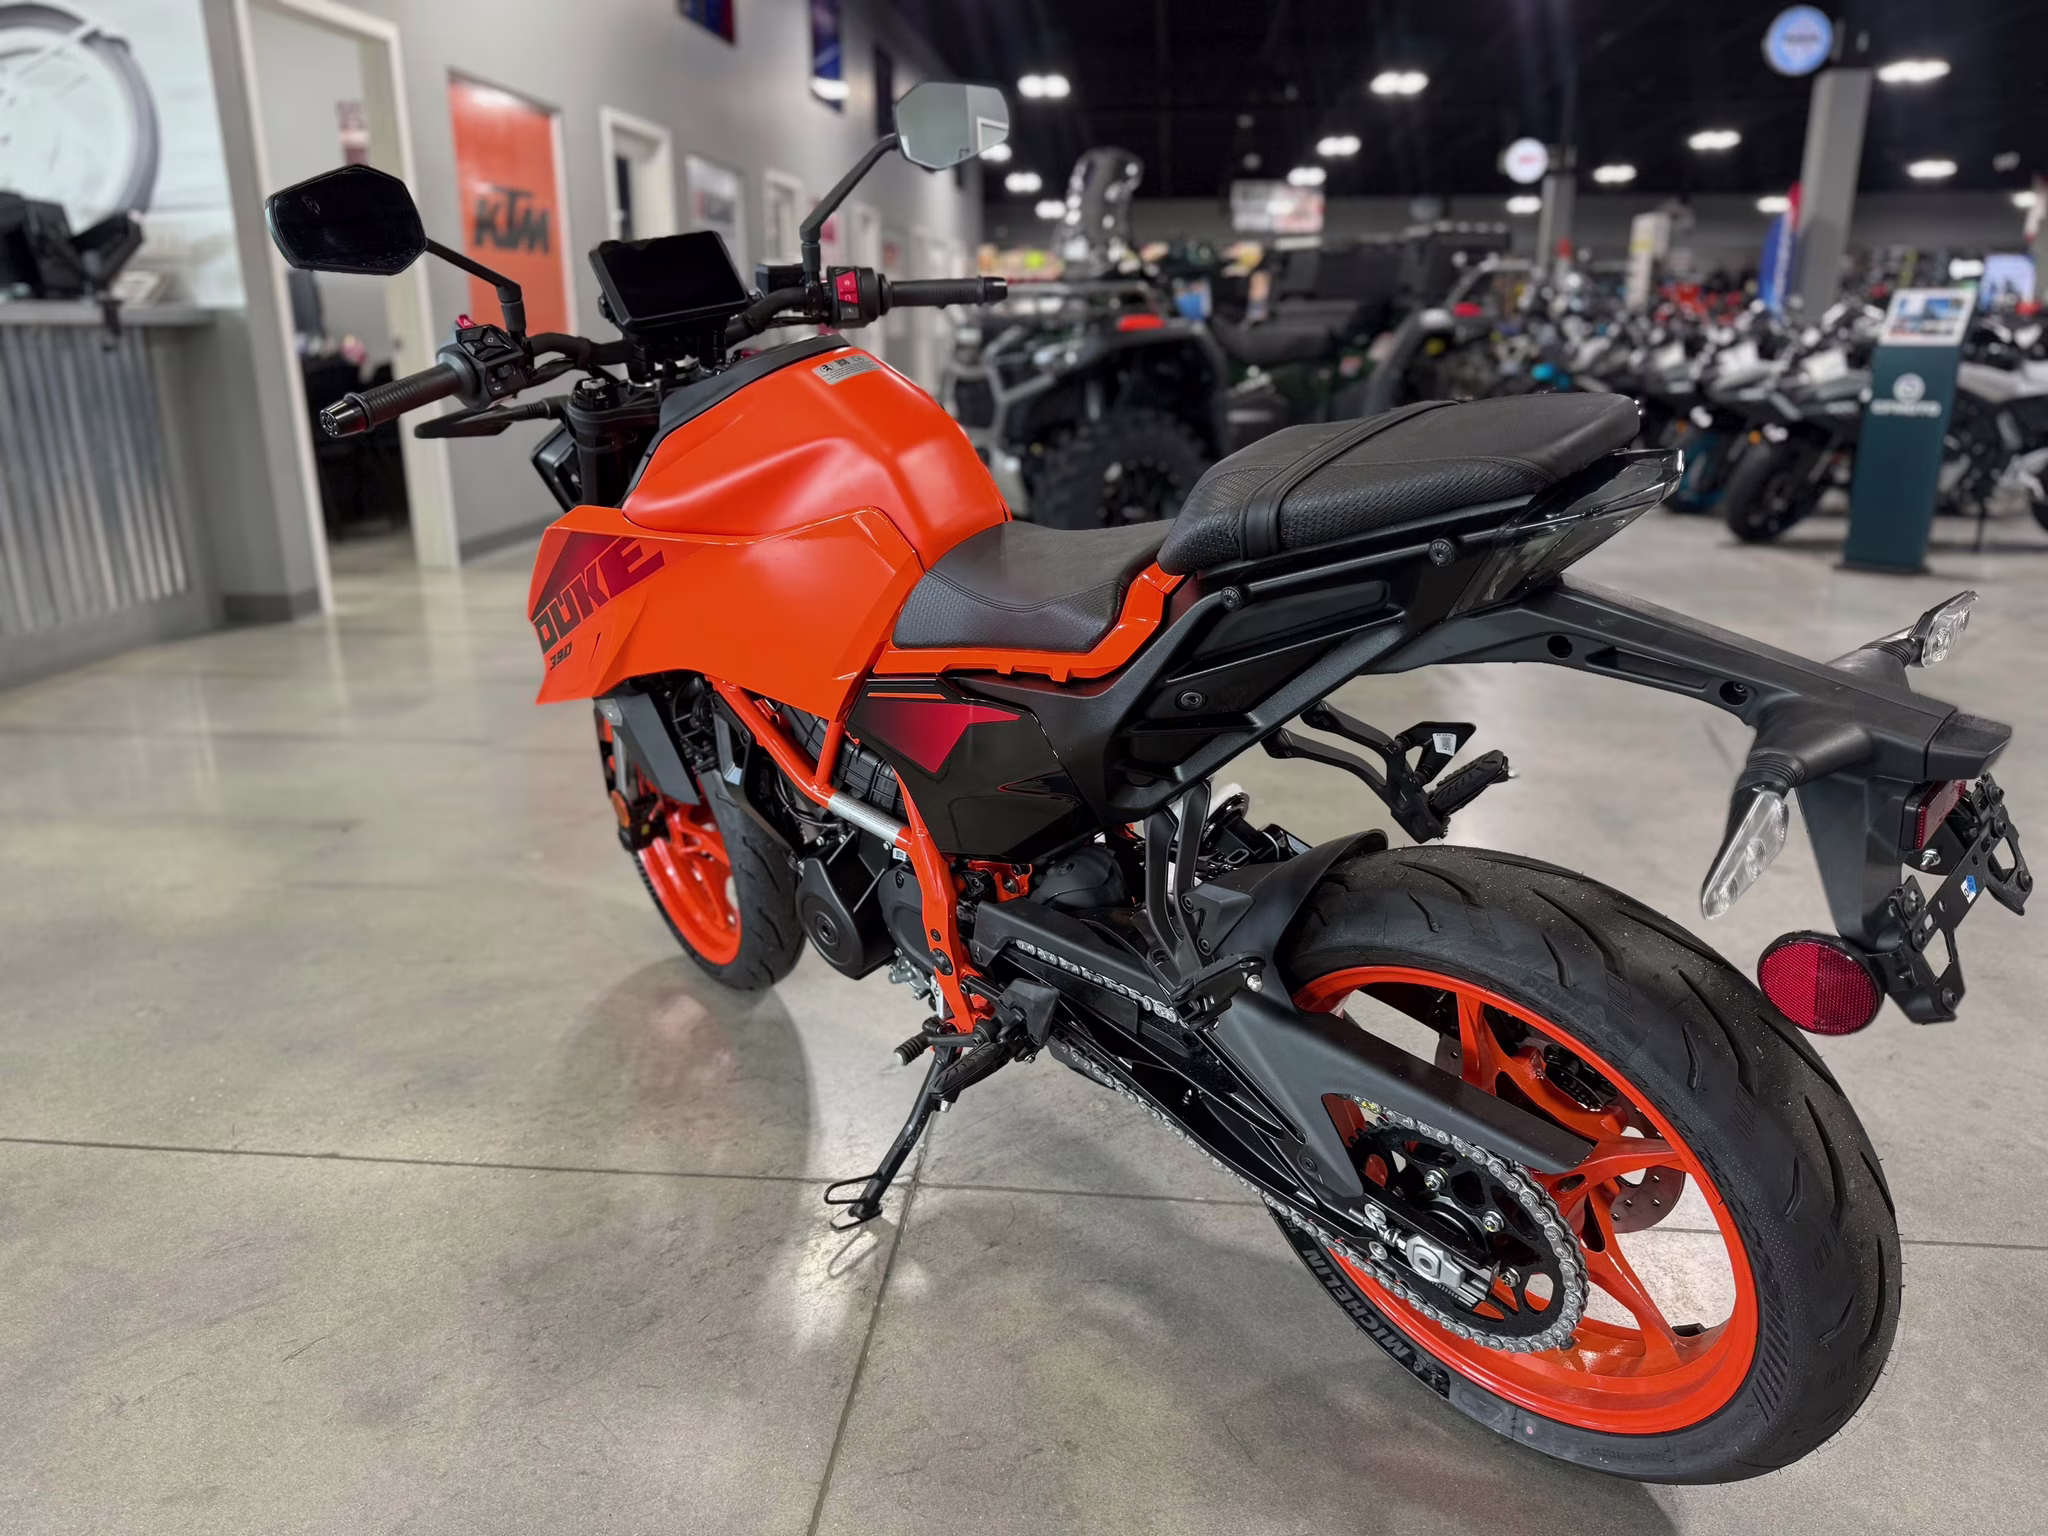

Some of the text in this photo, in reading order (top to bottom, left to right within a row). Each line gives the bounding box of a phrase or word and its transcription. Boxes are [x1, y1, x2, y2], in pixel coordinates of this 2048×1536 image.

[474, 186, 549, 255] KTM
[533, 537, 665, 655] DUKE
[550, 641, 573, 671] 390
[1303, 1250, 1410, 1358] MICHELIN
